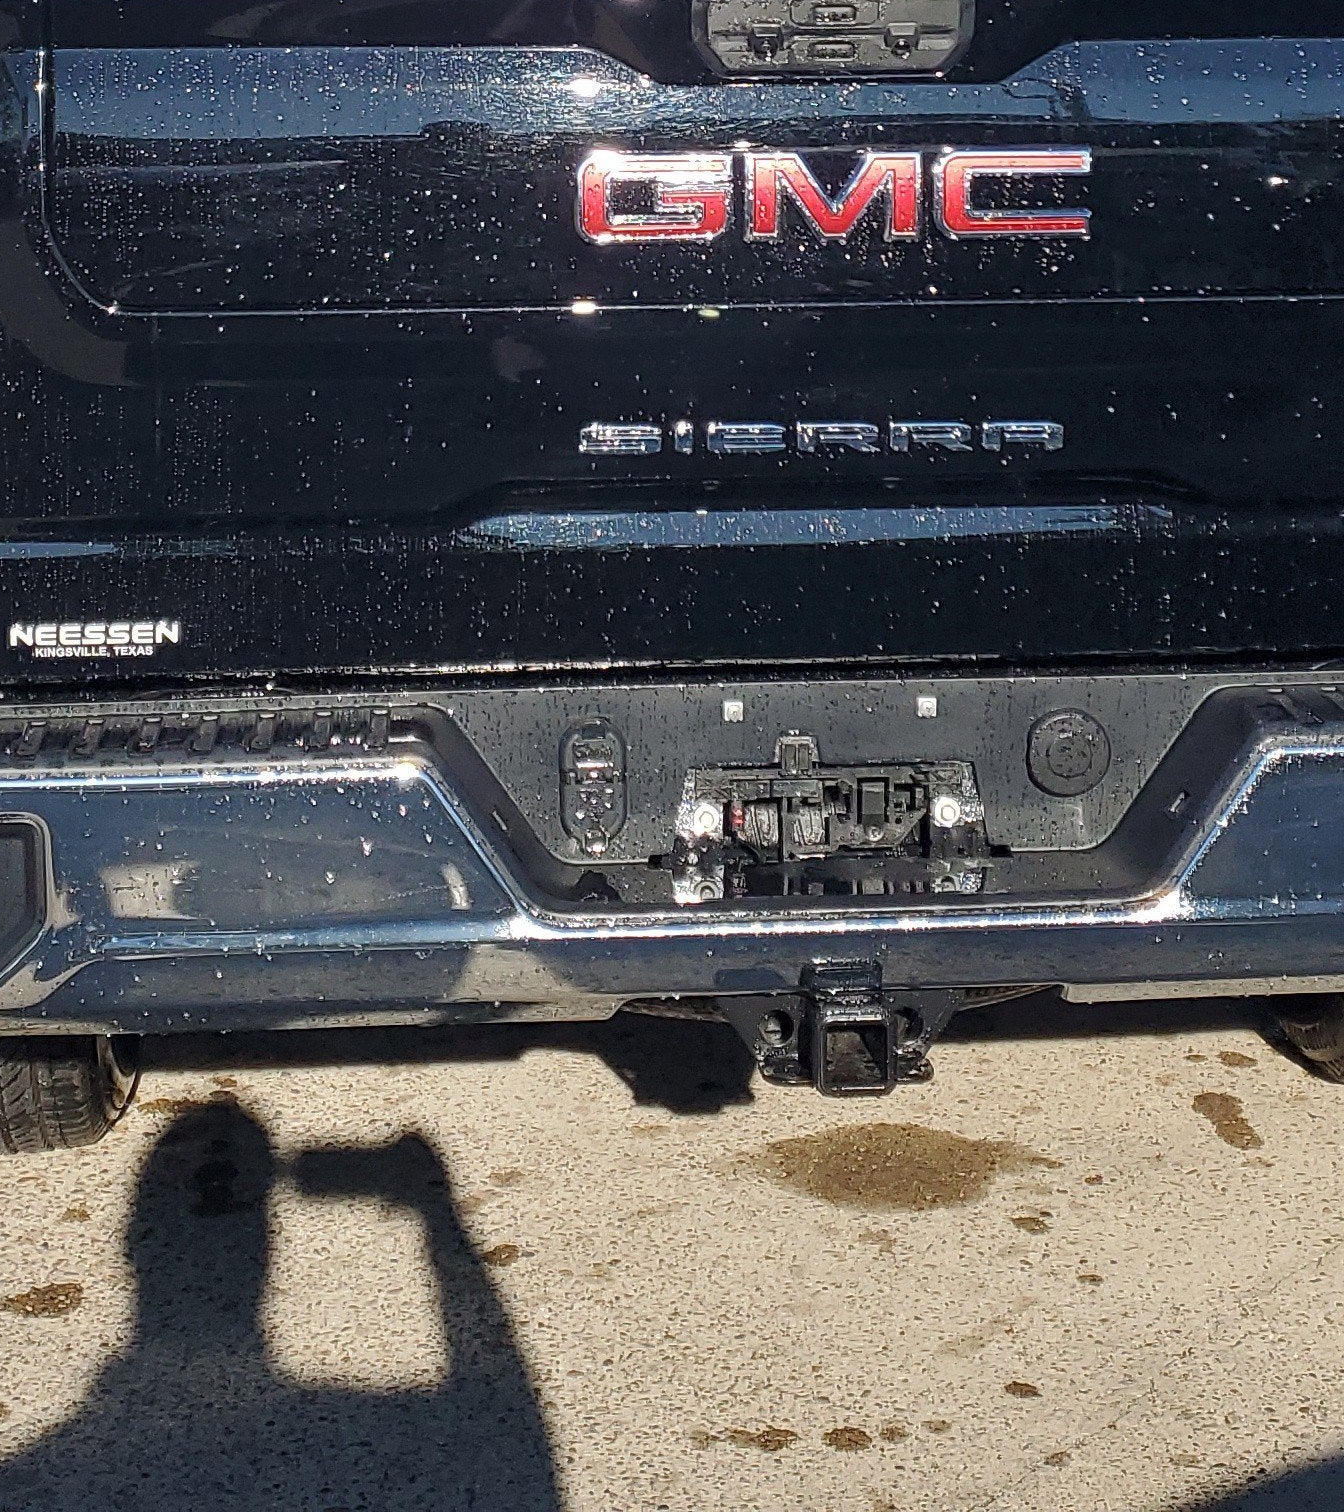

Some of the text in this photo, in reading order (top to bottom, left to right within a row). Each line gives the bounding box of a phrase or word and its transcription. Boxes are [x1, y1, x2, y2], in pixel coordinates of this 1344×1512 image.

[576, 145, 1093, 245] GMC
[579, 421, 1065, 455] SIERRA
[9, 620, 180, 647] NEESSEN
[34, 645, 154, 658] KINGSVILLE, TEXAS
